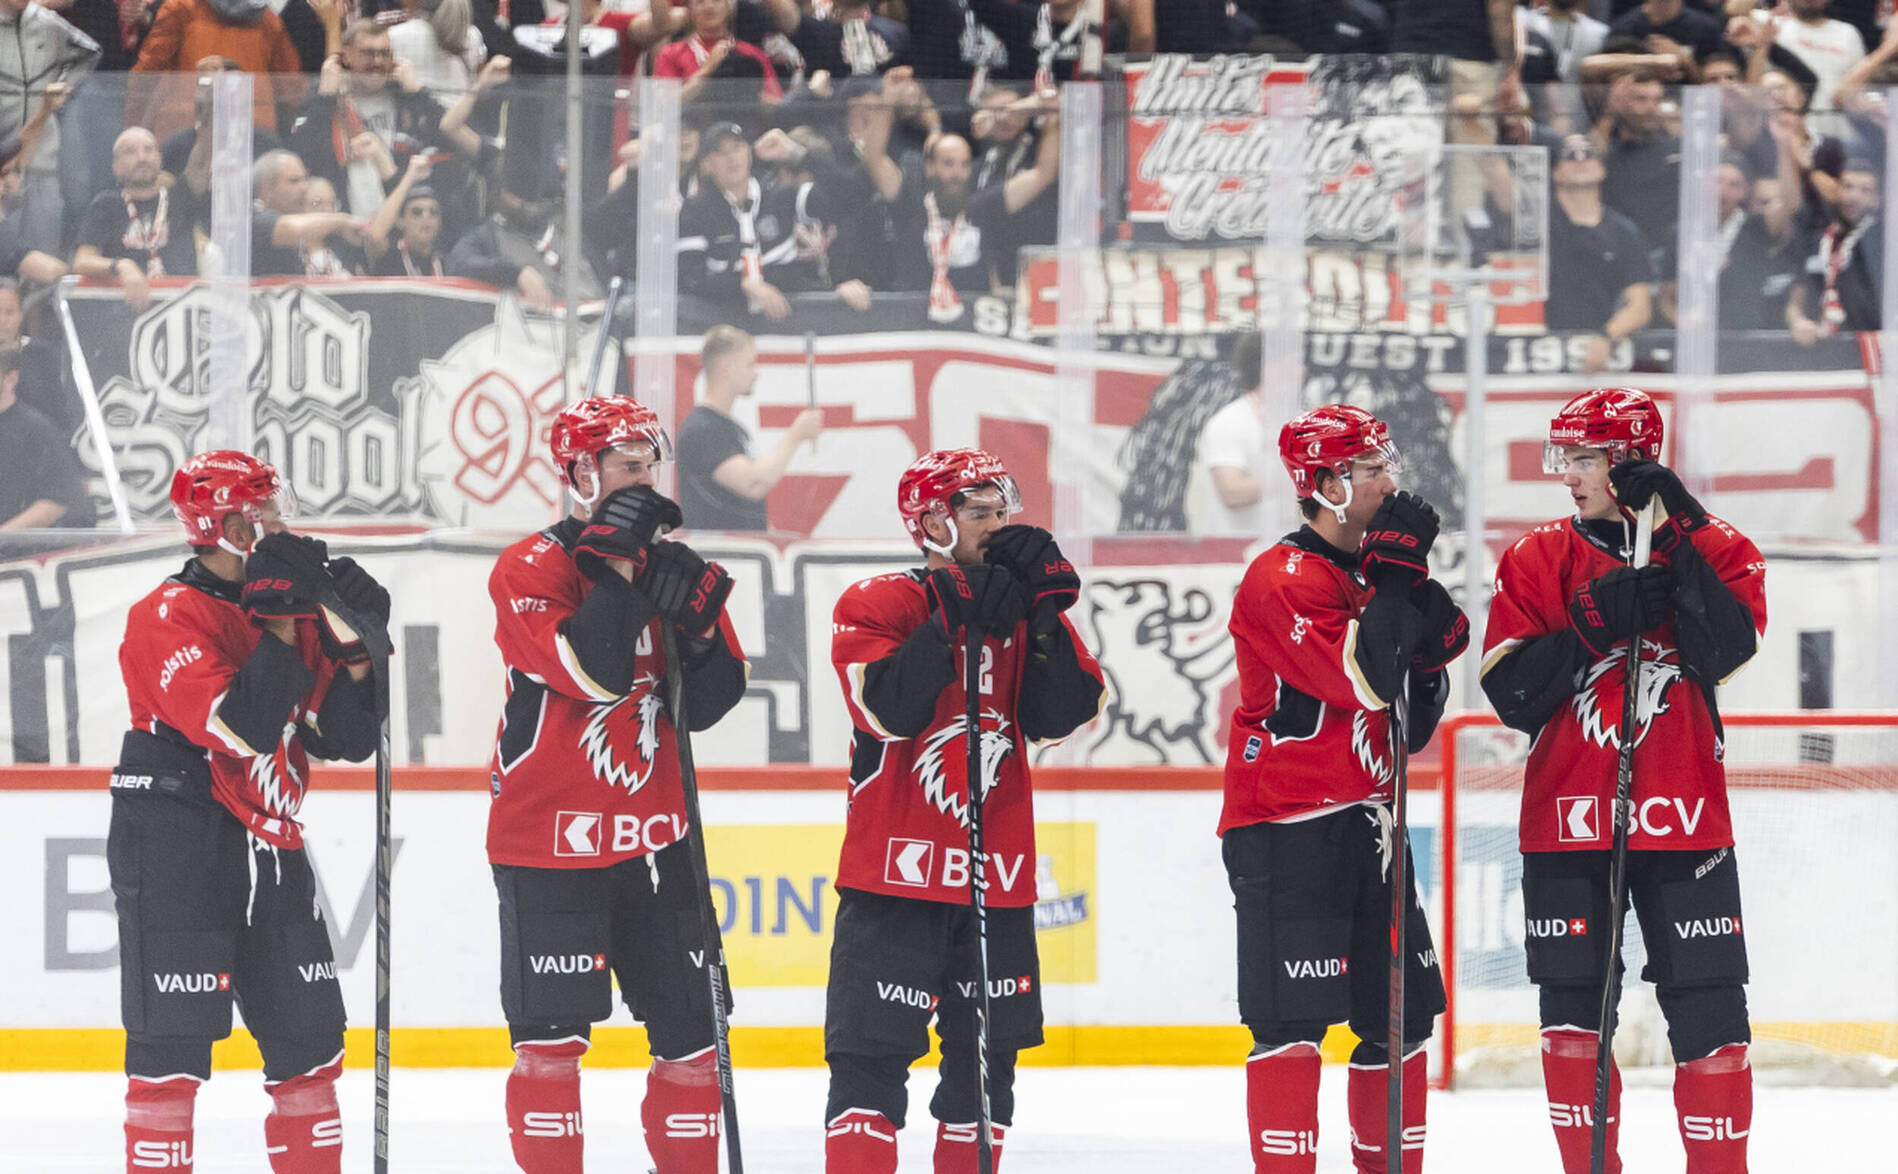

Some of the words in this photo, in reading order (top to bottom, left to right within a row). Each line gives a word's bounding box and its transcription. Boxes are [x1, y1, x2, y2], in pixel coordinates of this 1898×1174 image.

[128, 284, 372, 414] Old
[1675, 916, 1733, 939] VAUD
[530, 954, 593, 974] VAUD
[1284, 958, 1341, 979] VAUD
[154, 972, 218, 993] VAUD
[876, 980, 931, 1011] VAUD
